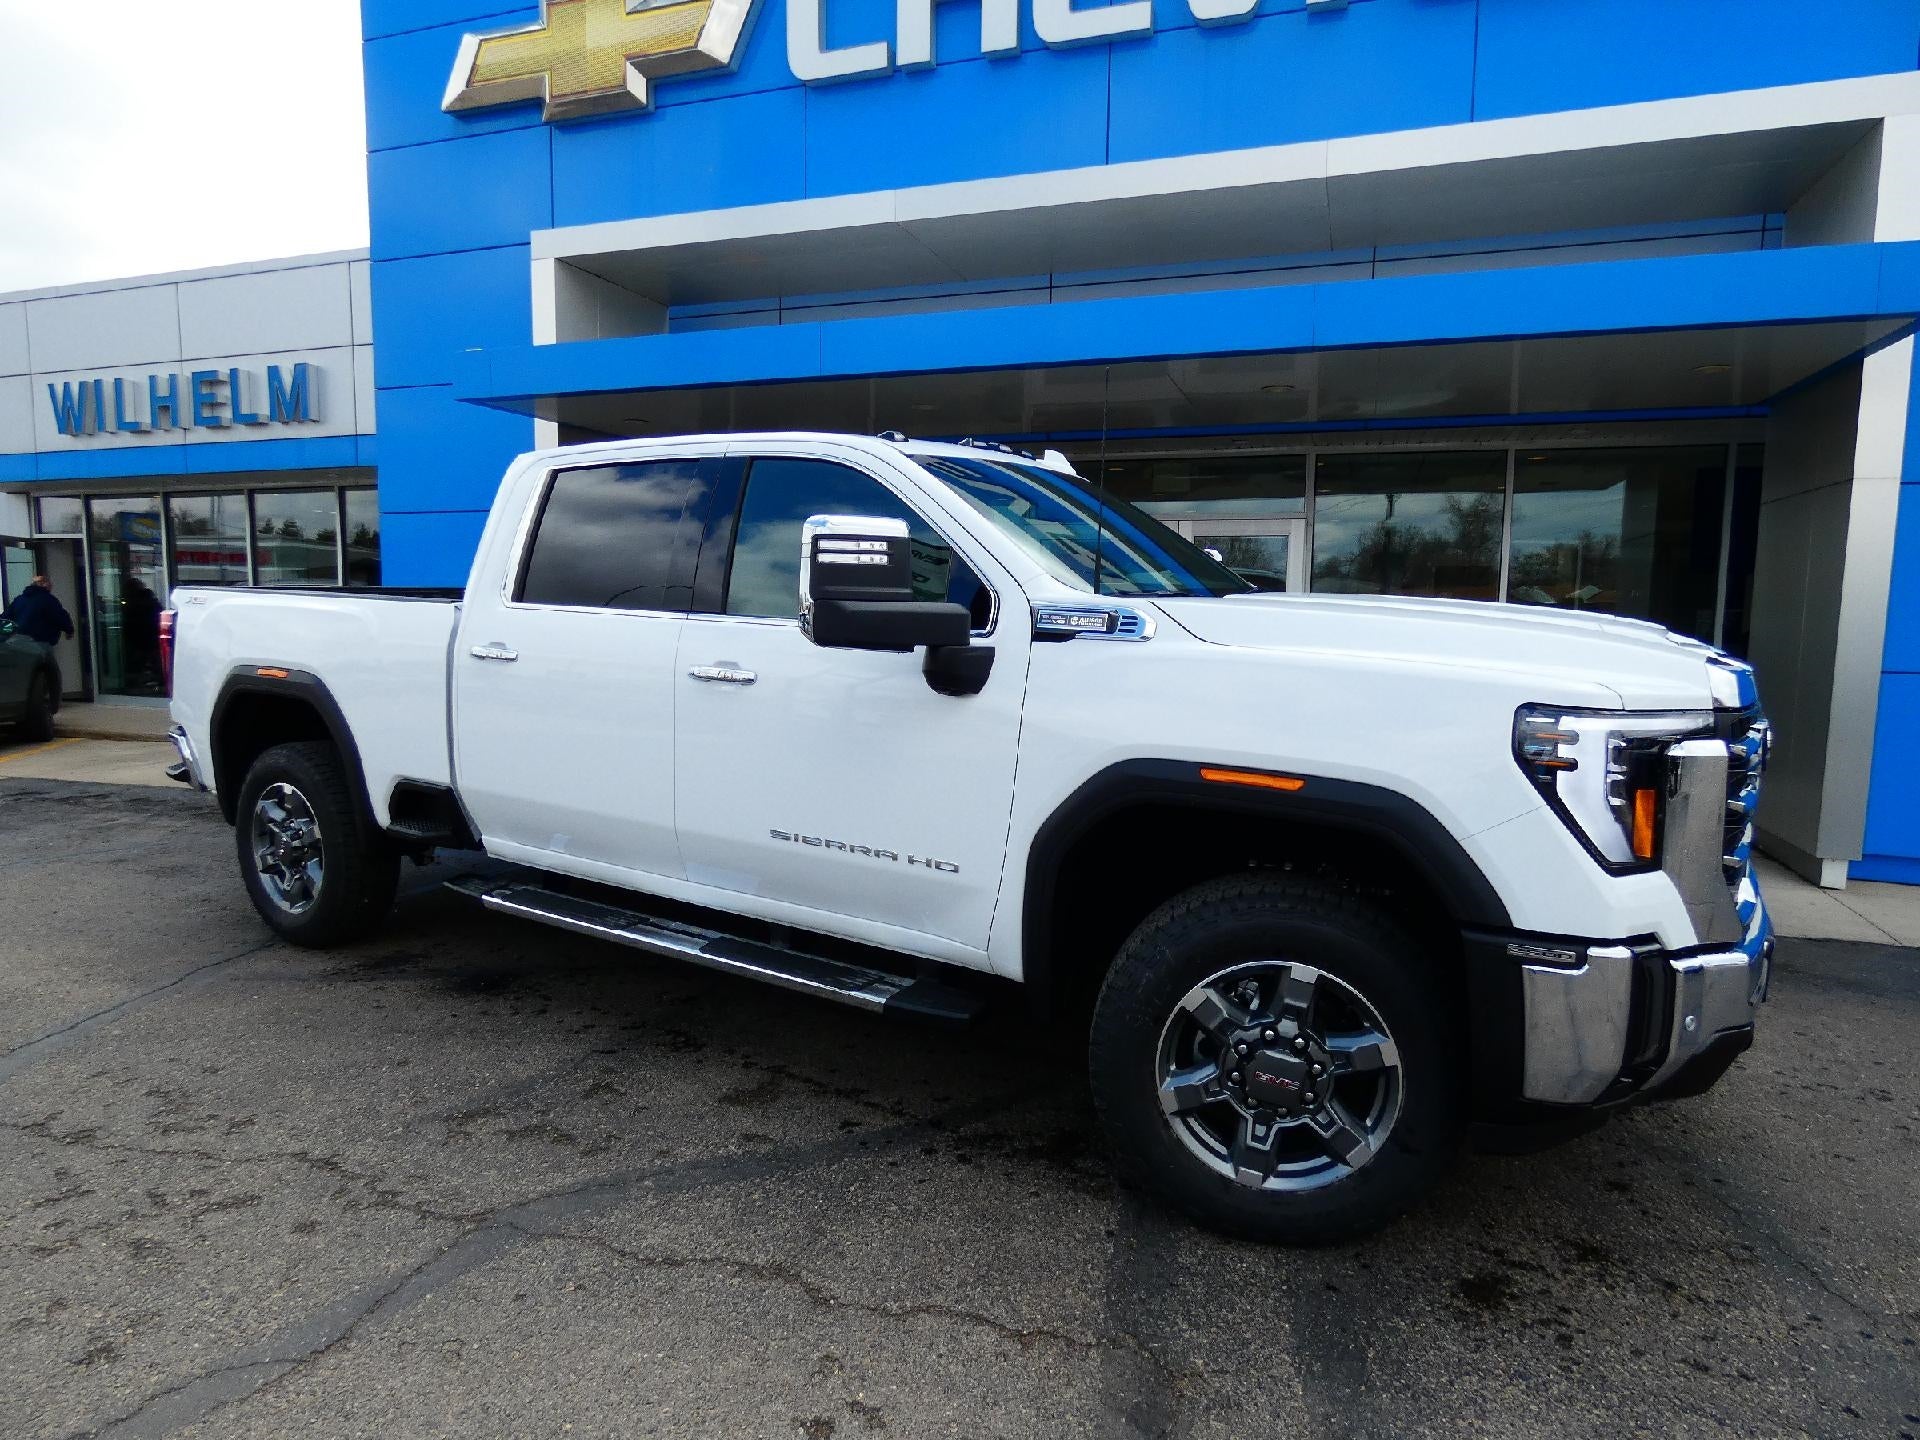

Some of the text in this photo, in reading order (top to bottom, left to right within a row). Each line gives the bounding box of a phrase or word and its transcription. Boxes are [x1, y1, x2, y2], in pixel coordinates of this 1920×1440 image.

[47, 362, 312, 436] WILHELM
[769, 828, 960, 874] SIERRA HD
[1254, 1070, 1301, 1091] GMC
